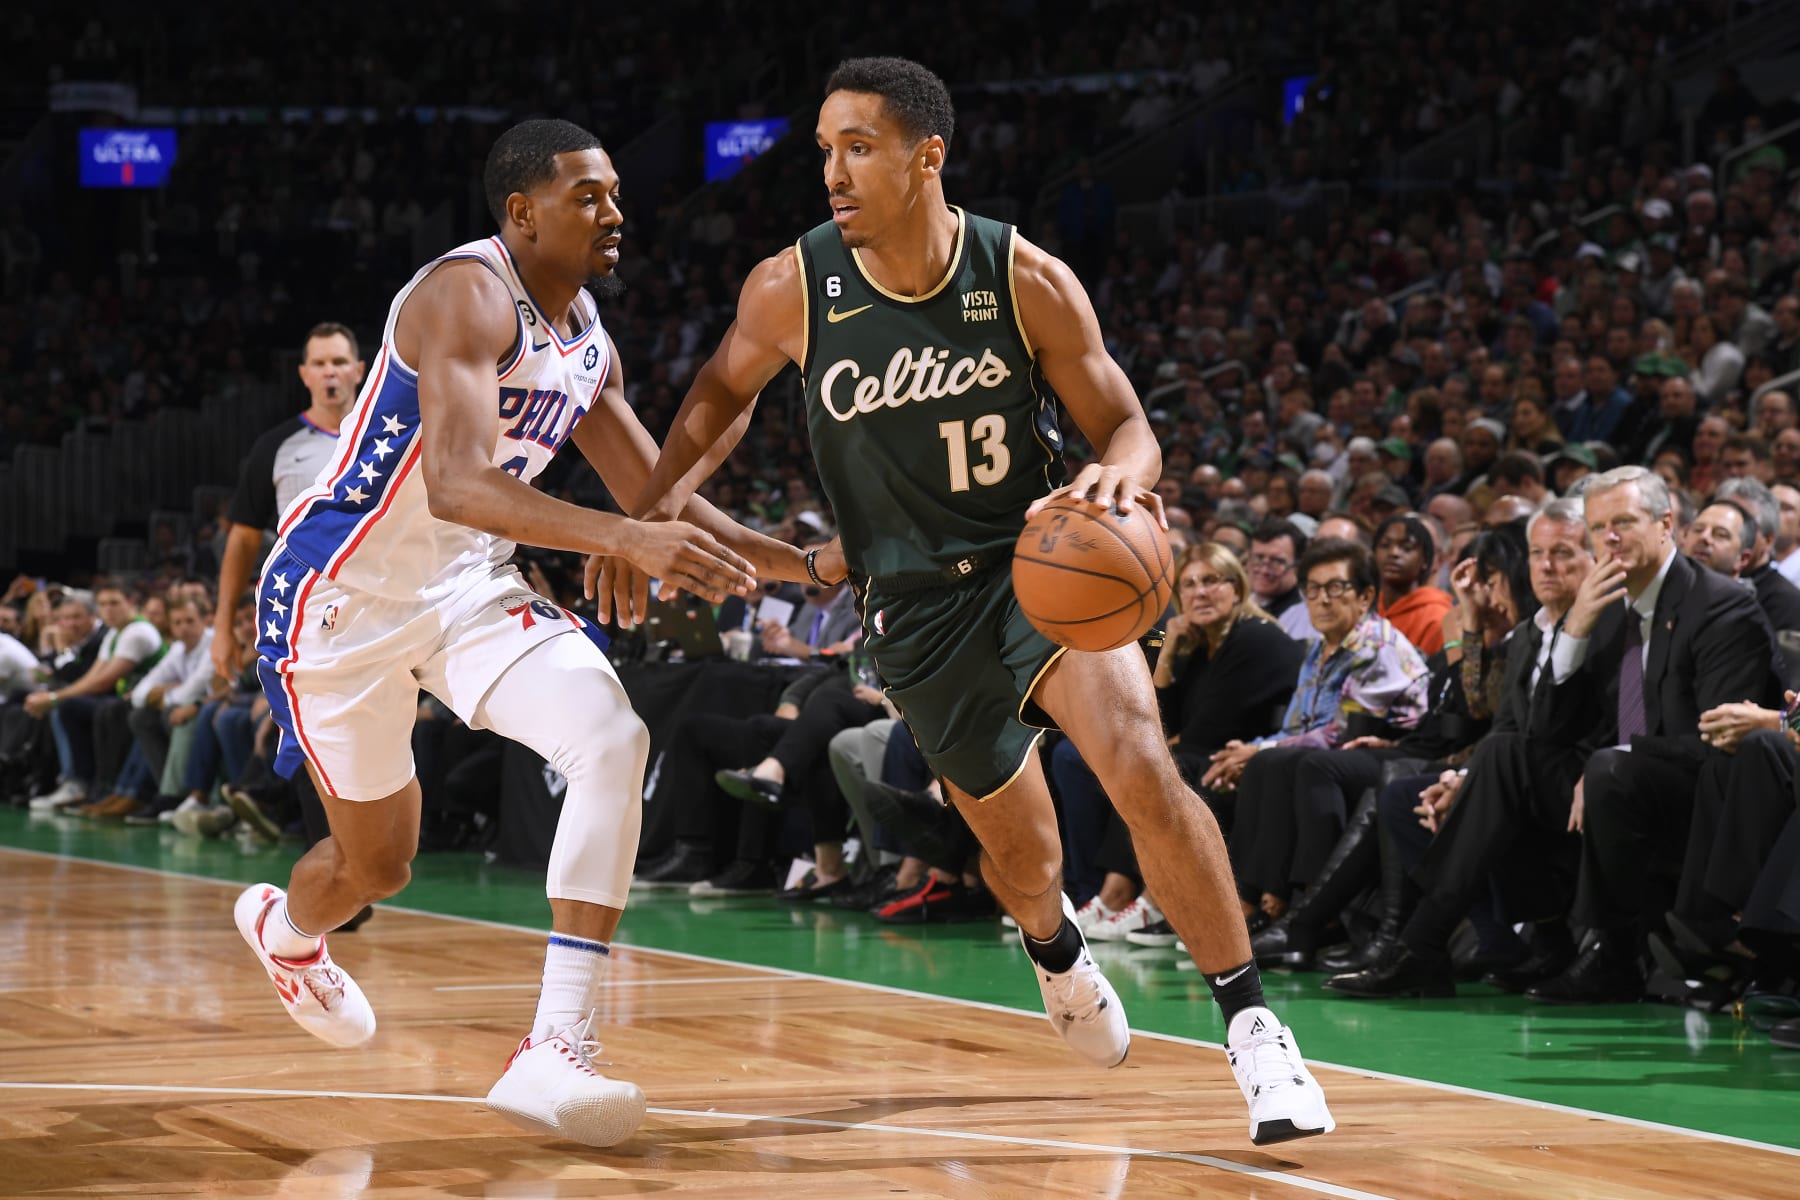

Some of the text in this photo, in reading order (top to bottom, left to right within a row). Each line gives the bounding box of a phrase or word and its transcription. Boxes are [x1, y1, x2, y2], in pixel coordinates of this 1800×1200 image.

[826, 276, 842, 298] 6
[962, 291, 997, 309] VISTA
[963, 307, 999, 322] PRINT
[820, 346, 1012, 422] Celtics
[938, 413, 1011, 493] 13
[957, 558, 972, 575] 6
[505, 600, 561, 632] 76
